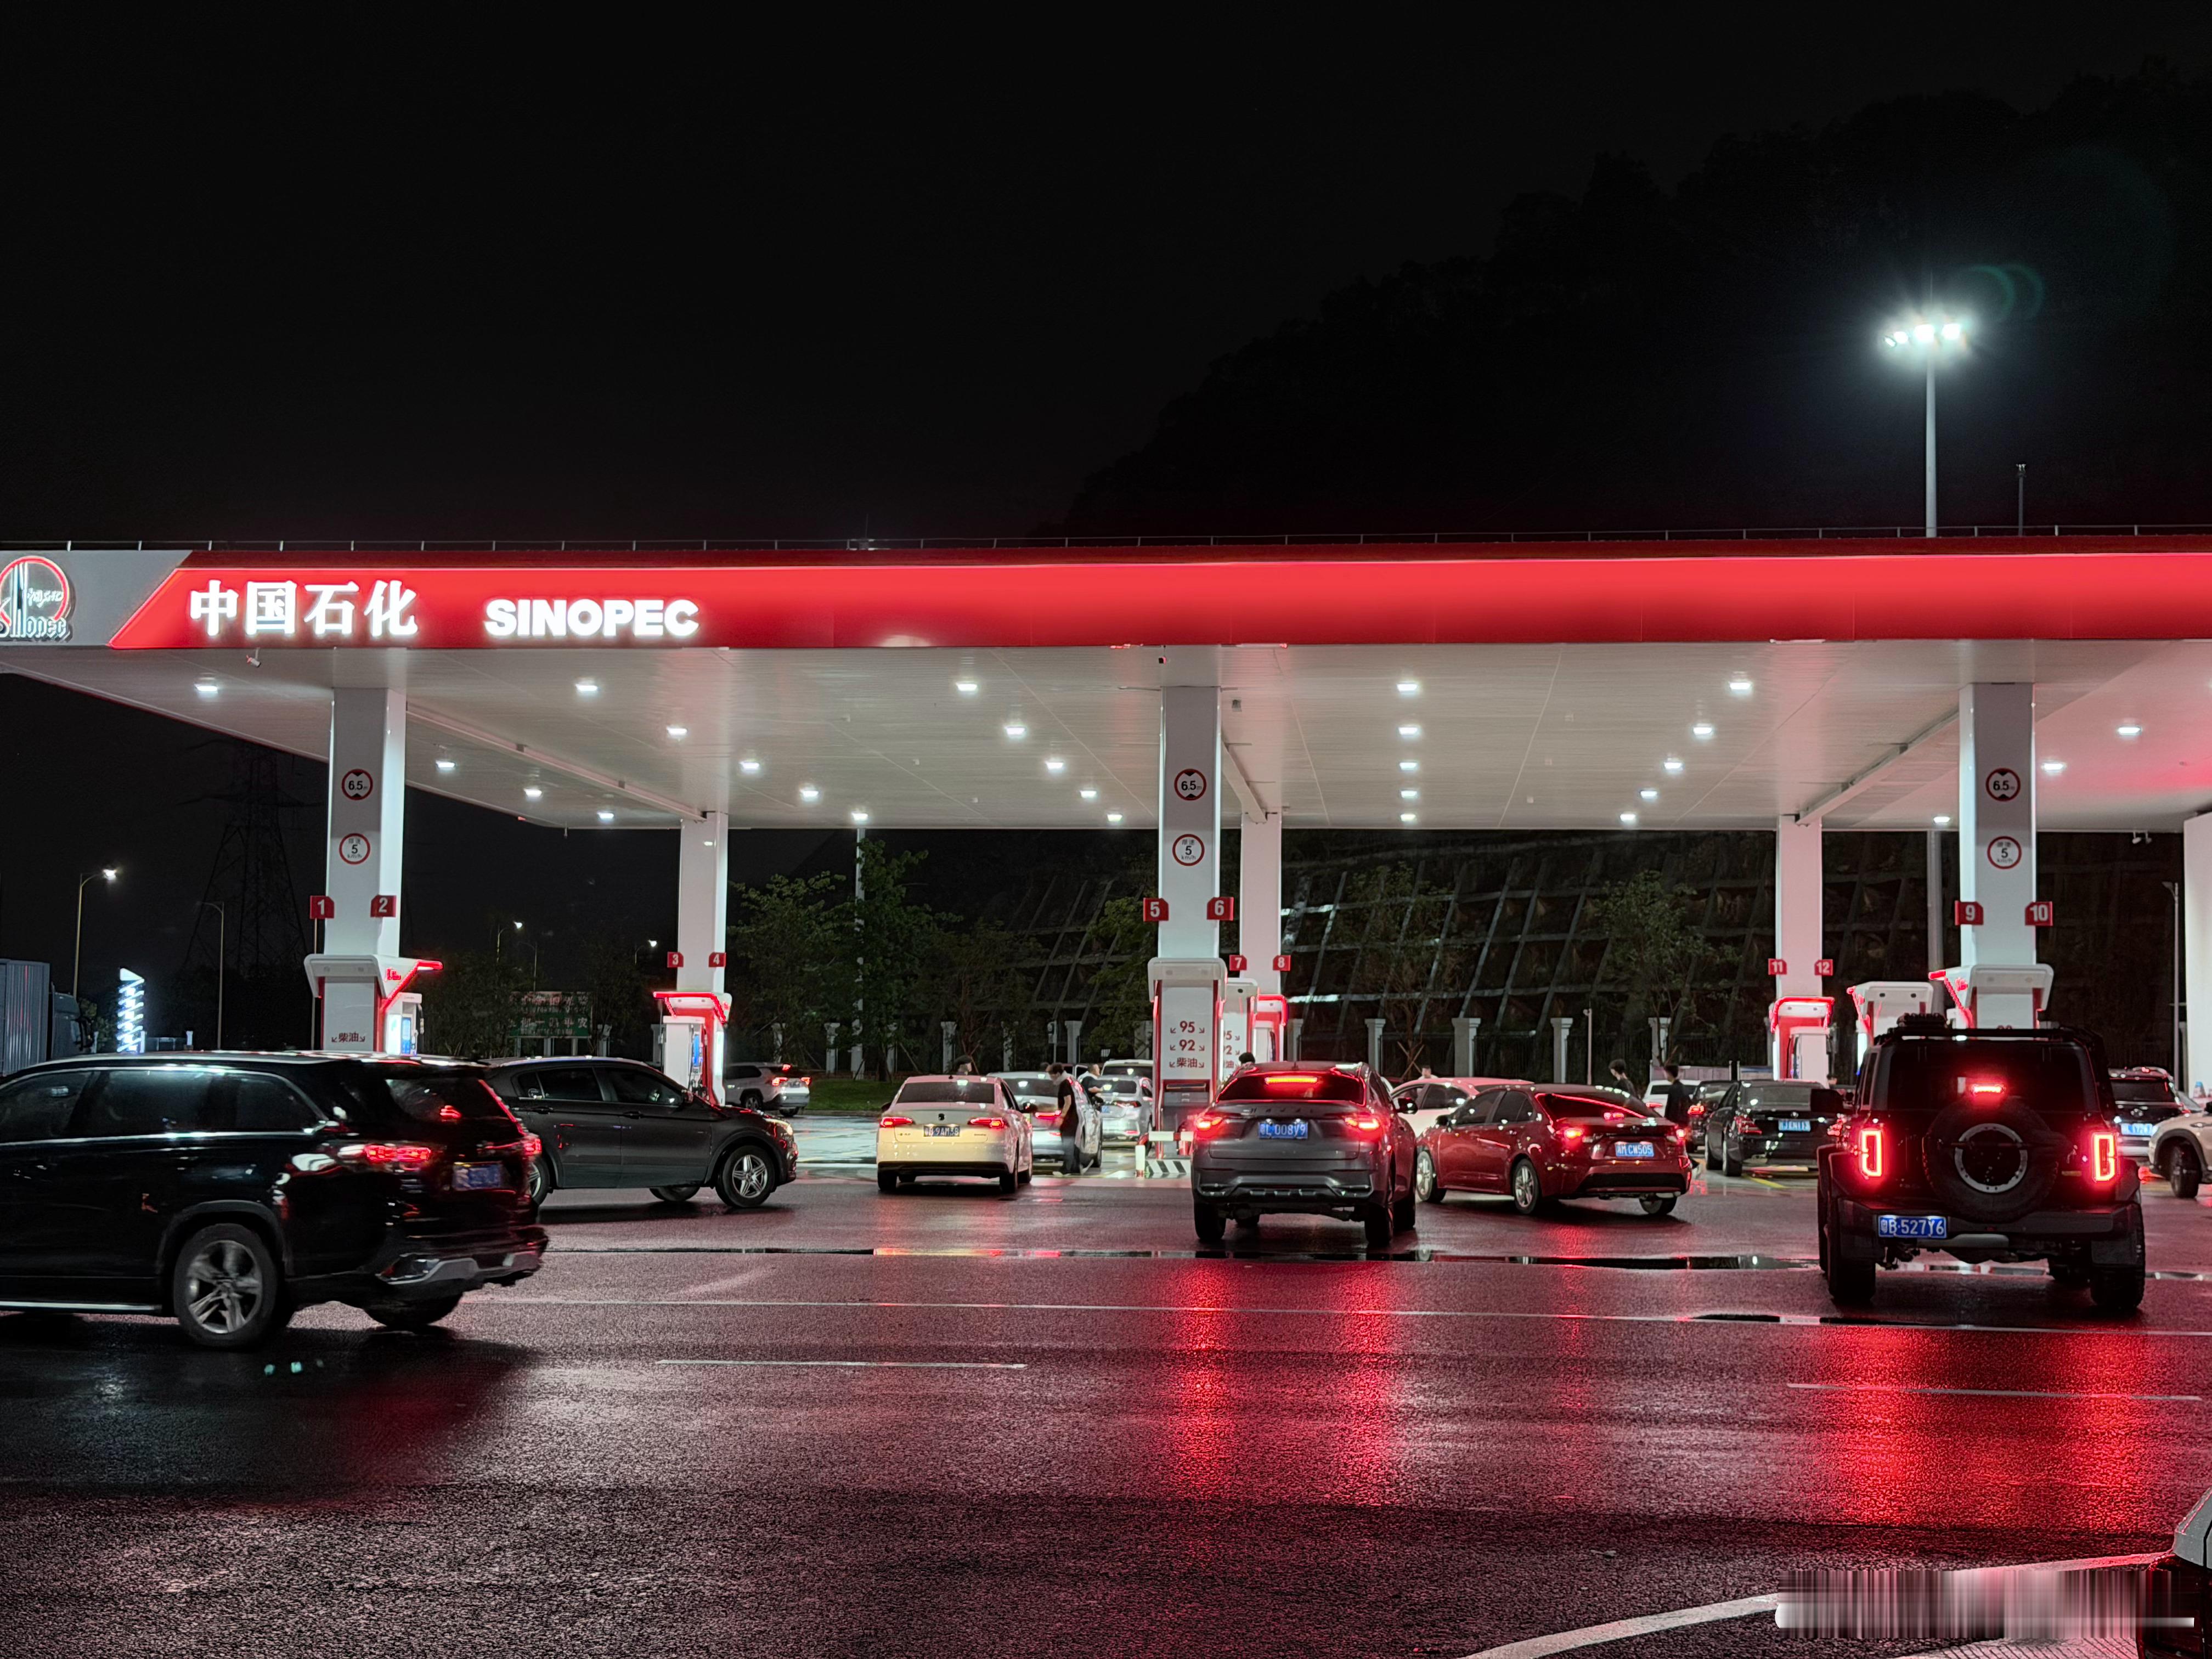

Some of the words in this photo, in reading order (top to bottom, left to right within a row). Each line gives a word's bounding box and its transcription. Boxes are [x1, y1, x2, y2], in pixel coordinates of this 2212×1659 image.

[189, 580, 418, 636] 中国石化
[484, 599, 699, 637] SINOPEC
[351, 844, 358, 854] 5
[1185, 845, 1192, 855] 5
[2001, 848, 2008, 859] 5
[318, 899, 325, 915] 1
[378, 898, 388, 913] 2
[1150, 901, 1160, 917] 5
[1214, 900, 1224, 916] 6
[1965, 905, 1975, 922] 9
[2029, 905, 2048, 922] 10
[672, 954, 679, 966] 3
[713, 953, 720, 966] 4
[1235, 957, 1242, 968] 7
[1277, 957, 1285, 968] 8
[1772, 961, 1783, 973] 11
[1816, 962, 1830, 974] 12
[1180, 1020, 1195, 1033] 95
[338, 1032, 359, 1042] 柴油
[1223, 1030, 1232, 1040] 5
[1179, 1039, 1195, 1051] 92
[1223, 1045, 1232, 1055] 2
[1177, 1057, 1198, 1068] 柴油
[1224, 1060, 1234, 1069] 油
